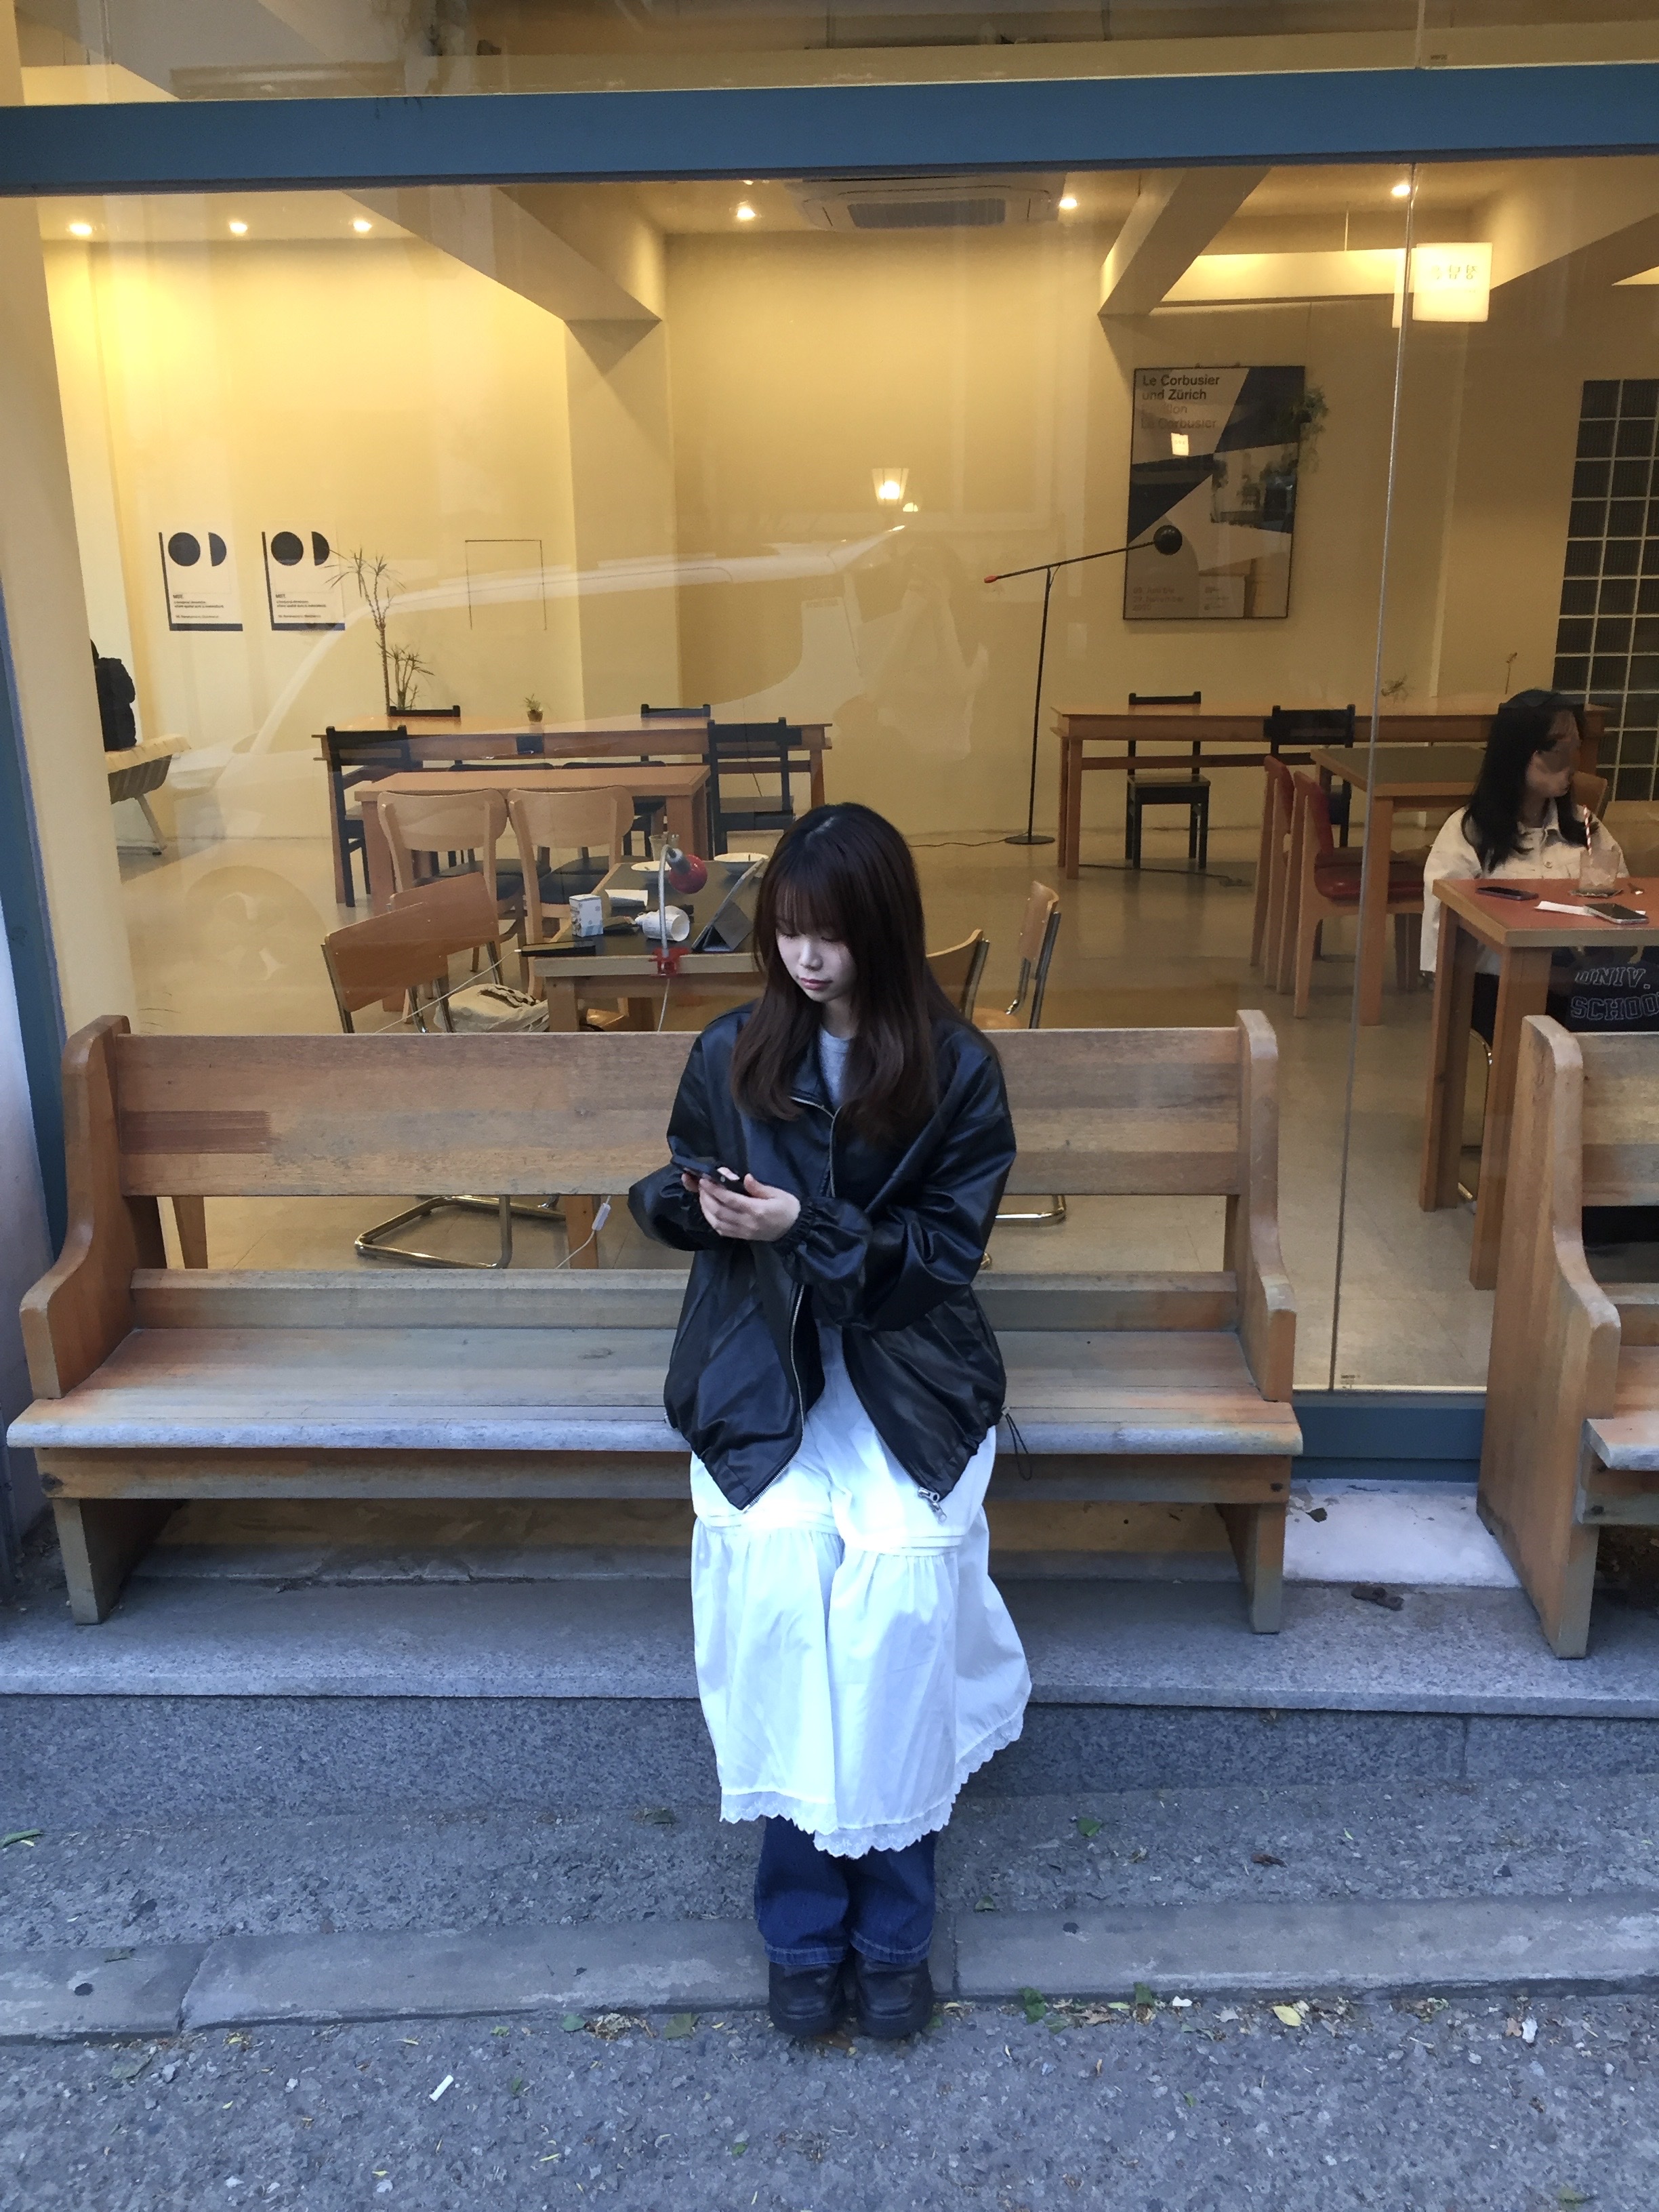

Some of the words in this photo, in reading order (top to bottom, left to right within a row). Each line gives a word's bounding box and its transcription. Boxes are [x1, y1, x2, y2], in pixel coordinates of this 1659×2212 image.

[1143, 374, 1157, 386] Le
[1160, 373, 1220, 386] Corbusier
[1142, 389, 1165, 401] und
[1168, 388, 1207, 401] Zürich
[1574, 966, 1651, 989] UNIV.
[1570, 991, 1659, 1021] SCHOO
